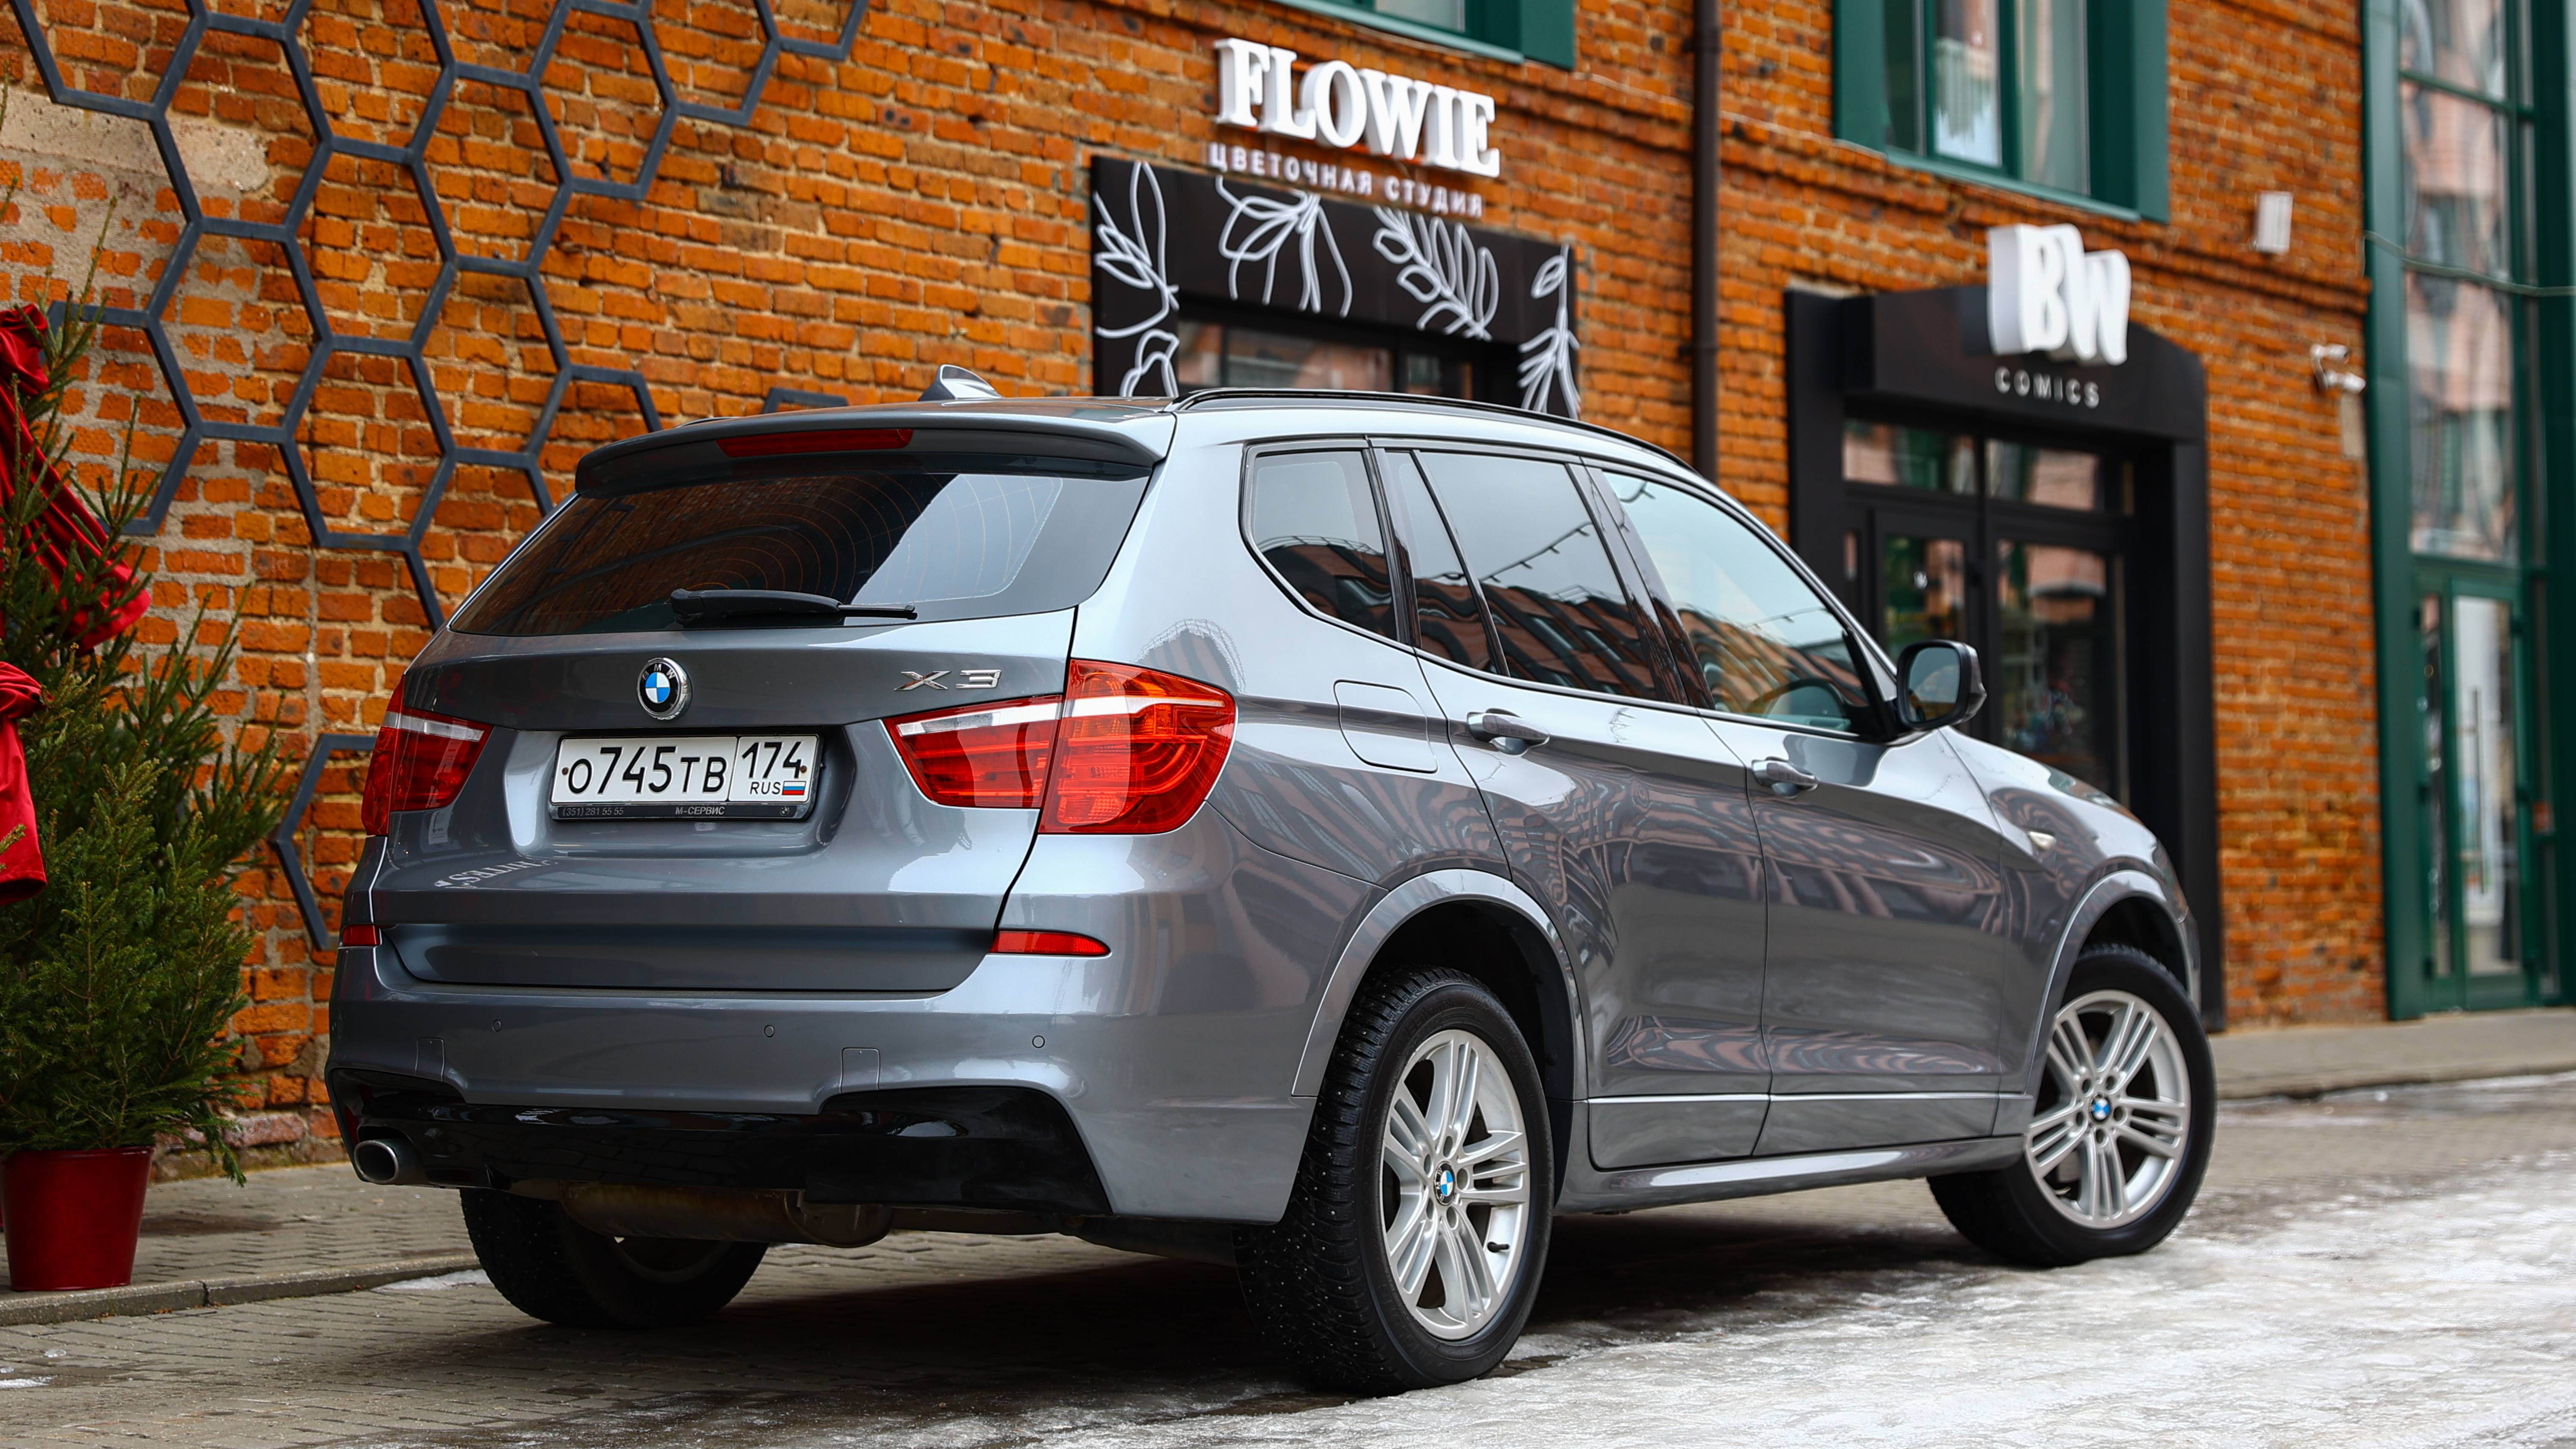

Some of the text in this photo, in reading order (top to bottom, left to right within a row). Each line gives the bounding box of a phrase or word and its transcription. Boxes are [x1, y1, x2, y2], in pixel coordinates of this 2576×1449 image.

[1215, 37, 1500, 178] FLOWIE
[1208, 142, 1482, 216] ЦВЕТОЧНАЯ СТУДИЯ
[1987, 223, 2132, 366] BW
[1995, 366, 2099, 409] COMICS
[642, 664, 675, 680] BMW
[894, 670, 1001, 690] X3
[742, 741, 802, 779] 174
[750, 782, 781, 795] RUS
[563, 807, 624, 816] (351) 281 55 55
[675, 806, 725, 815] М-СЕРВИС
